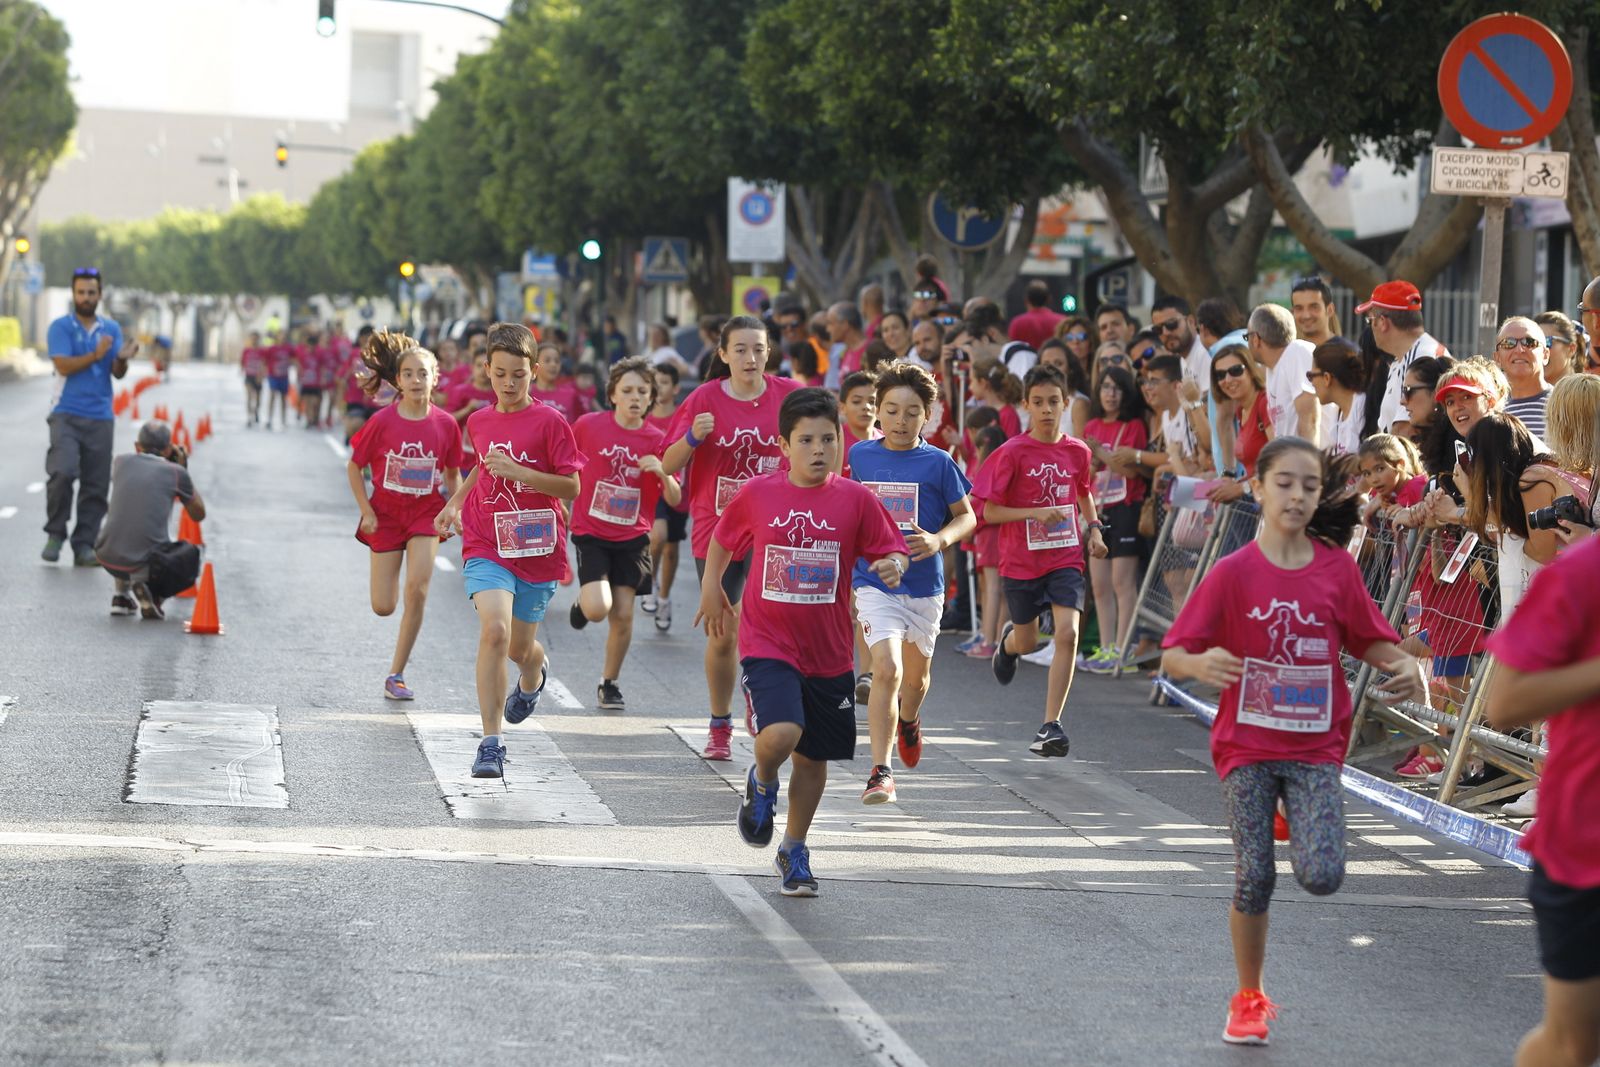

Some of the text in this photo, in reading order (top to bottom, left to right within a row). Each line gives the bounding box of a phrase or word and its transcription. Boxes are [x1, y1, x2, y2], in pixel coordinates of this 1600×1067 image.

[1440, 153, 1520, 166] EXCEPTO MOTOS
[1448, 178, 1510, 191] Y BICICLETAS
[788, 565, 833, 582] 1525
[1270, 686, 1327, 705] 1940
